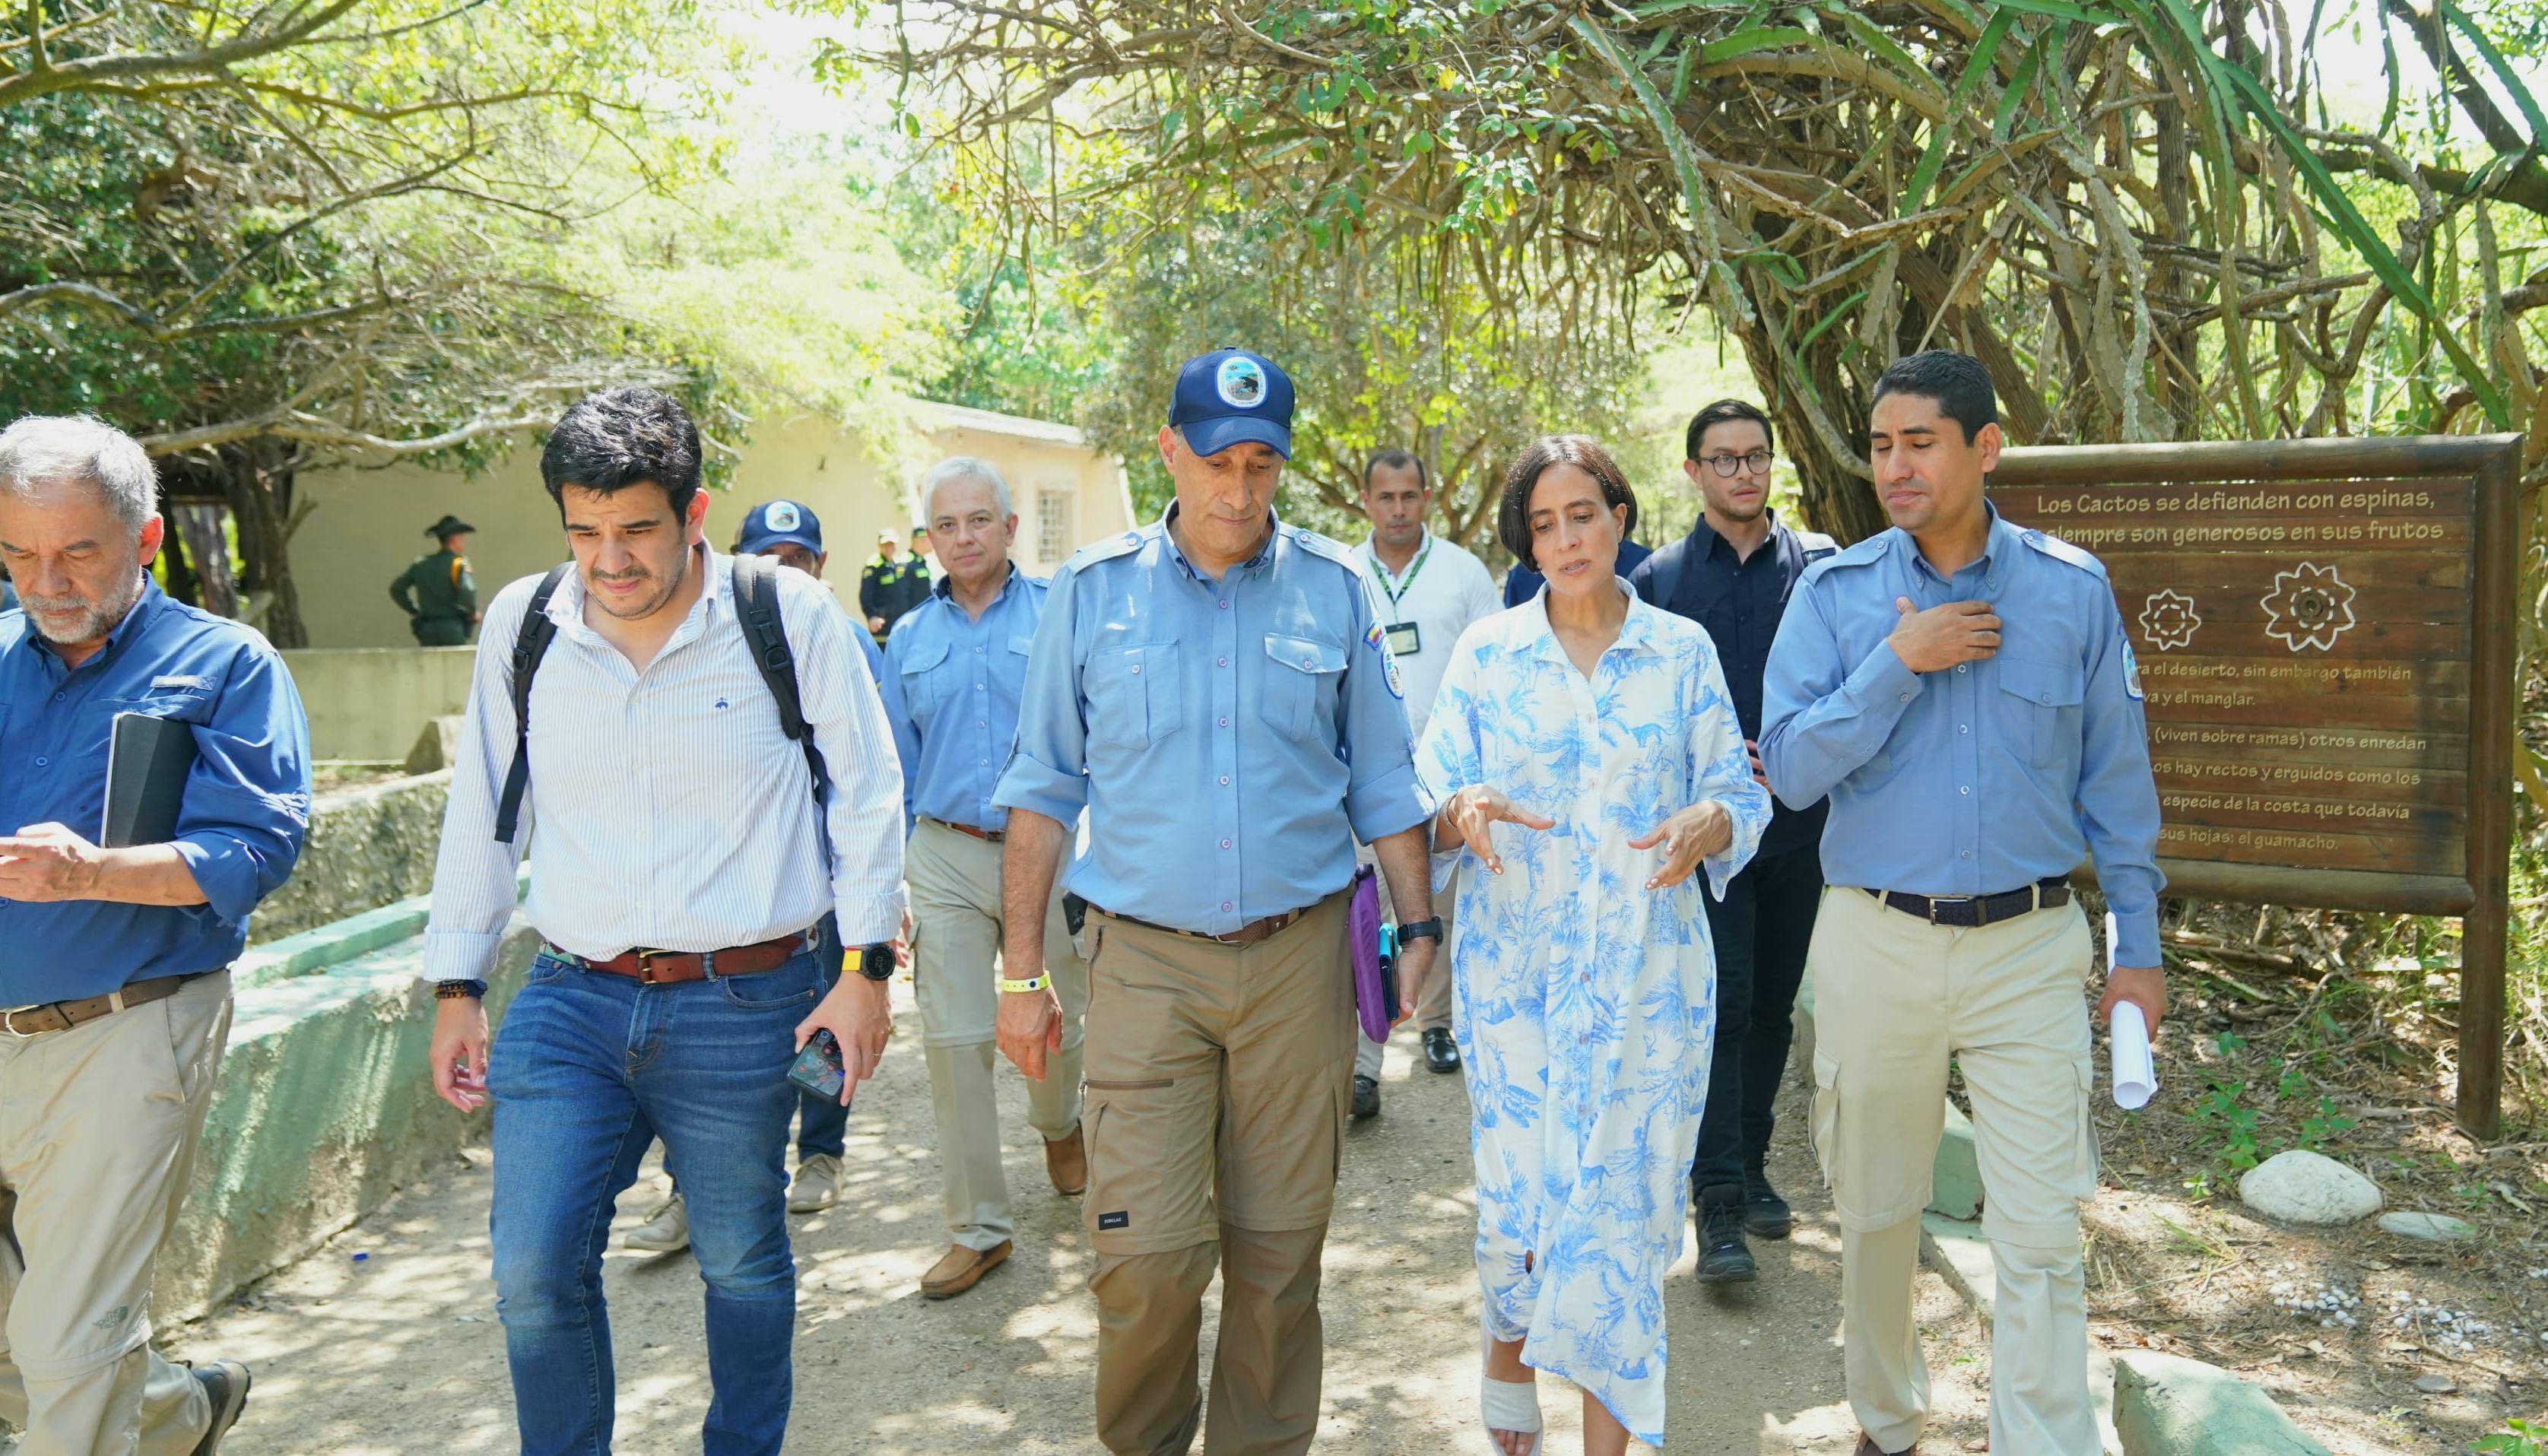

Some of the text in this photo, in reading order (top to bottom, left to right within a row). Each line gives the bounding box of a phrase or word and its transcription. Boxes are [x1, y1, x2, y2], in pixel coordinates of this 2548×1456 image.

[2038, 489, 2435, 515] Los Cactos se defienden con espinas,
[2131, 528, 2167, 542] son
[2172, 526, 2285, 547] generosos
[2291, 525, 2315, 541] en
[2322, 525, 2362, 540] sus
[2154, 662, 2166, 675] el
[2170, 662, 2239, 678] desierto,
[2244, 665, 2266, 677] sin
[2270, 664, 2339, 682] embargo
[2343, 665, 2411, 680] también
[2162, 693, 2172, 706] y
[2175, 690, 2187, 704] el
[2191, 692, 2256, 709] manglar.
[2155, 726, 2426, 750] (viven sobre ramas) otros enredan
[2175, 760, 2202, 778] hay
[2206, 763, 2258, 777] rectos
[2261, 767, 2271, 782] y
[2274, 766, 2343, 783] erguidos
[2347, 771, 2391, 784] como
[2396, 770, 2421, 785] los
[2162, 795, 2410, 820] especie de la costa que todavía
[2159, 827, 2338, 849] sus hojas: el guamacho.
